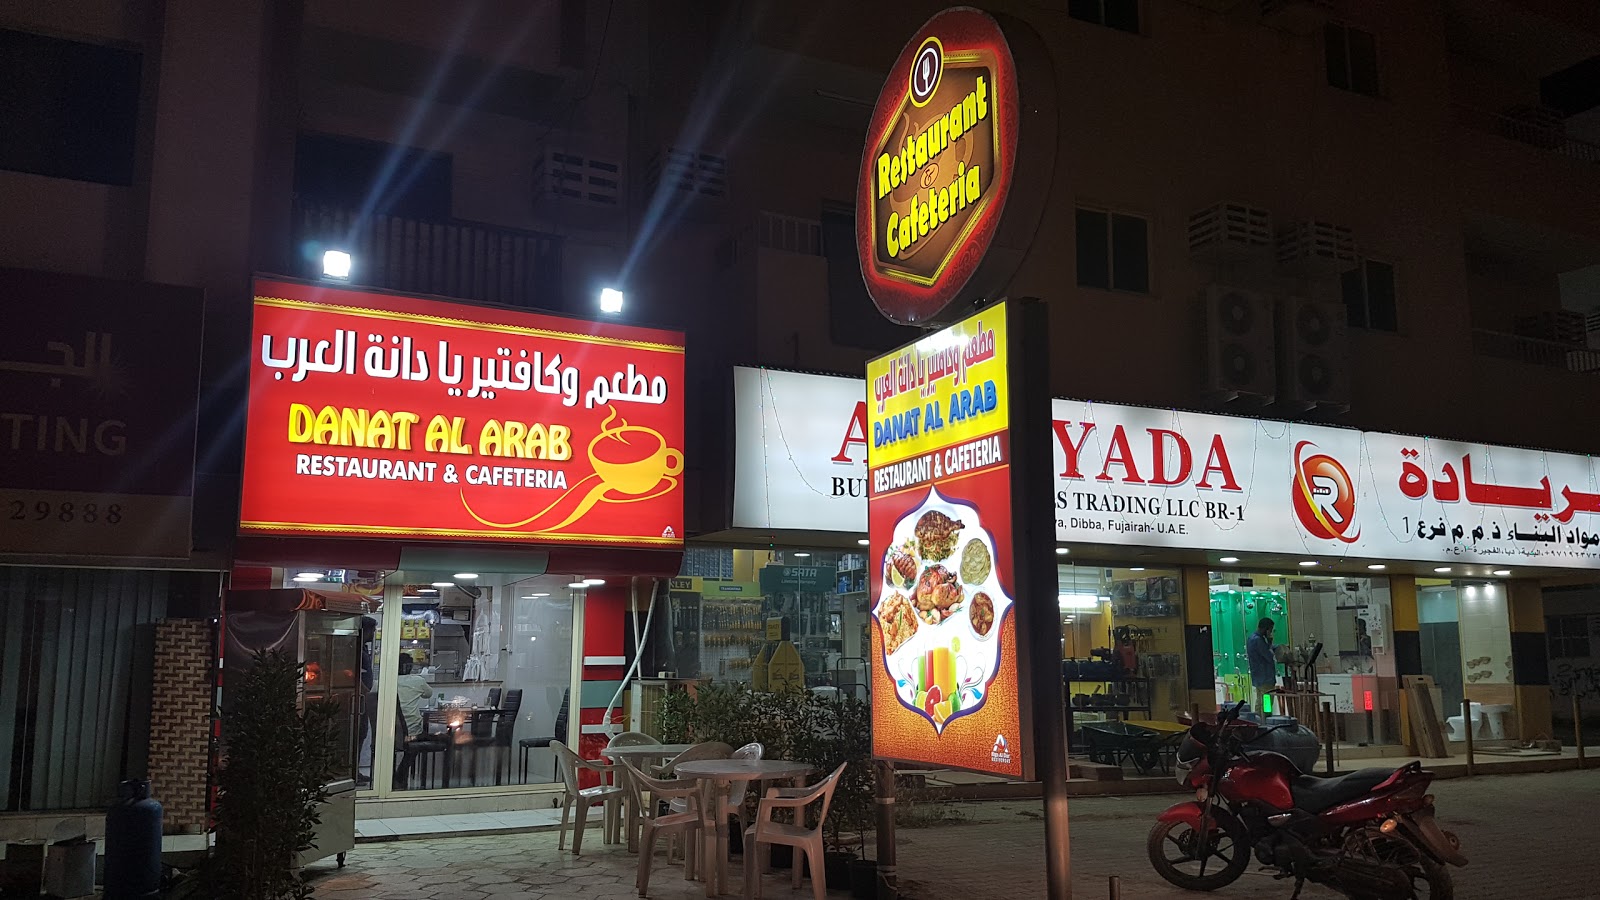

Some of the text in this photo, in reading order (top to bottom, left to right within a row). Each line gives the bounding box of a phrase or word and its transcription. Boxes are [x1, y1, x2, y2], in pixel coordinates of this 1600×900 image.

[877, 76, 988, 200] Restaurant
[886, 164, 981, 258] Cafeteria
[262, 329, 357, 382] العرب
[364, 333, 429, 381] دانة
[962, 321, 995, 384] مطعم
[585, 362, 667, 409] مطعم
[874, 359, 898, 413] العرب
[288, 403, 573, 461] DANAT AL ARAB
[874, 379, 997, 449] DANAT AL ARAB
[296, 454, 568, 489] RESTAURANT & CAFETERIA
[874, 436, 1002, 493] RESTAURANT & CAFETERIA
[1070, 517, 1105, 531] Dibba,
[1157, 523, 1189, 535] U.A.E.
[1073, 492, 1161, 516] TRADING
[1166, 499, 1201, 518] LLC
[1206, 503, 1245, 521] BR-1
[1417, 517, 1447, 540] فرع
[1507, 522, 1561, 547] البناء
[1566, 527, 1600, 549] مواد
[791, 567, 817, 577] SATA
